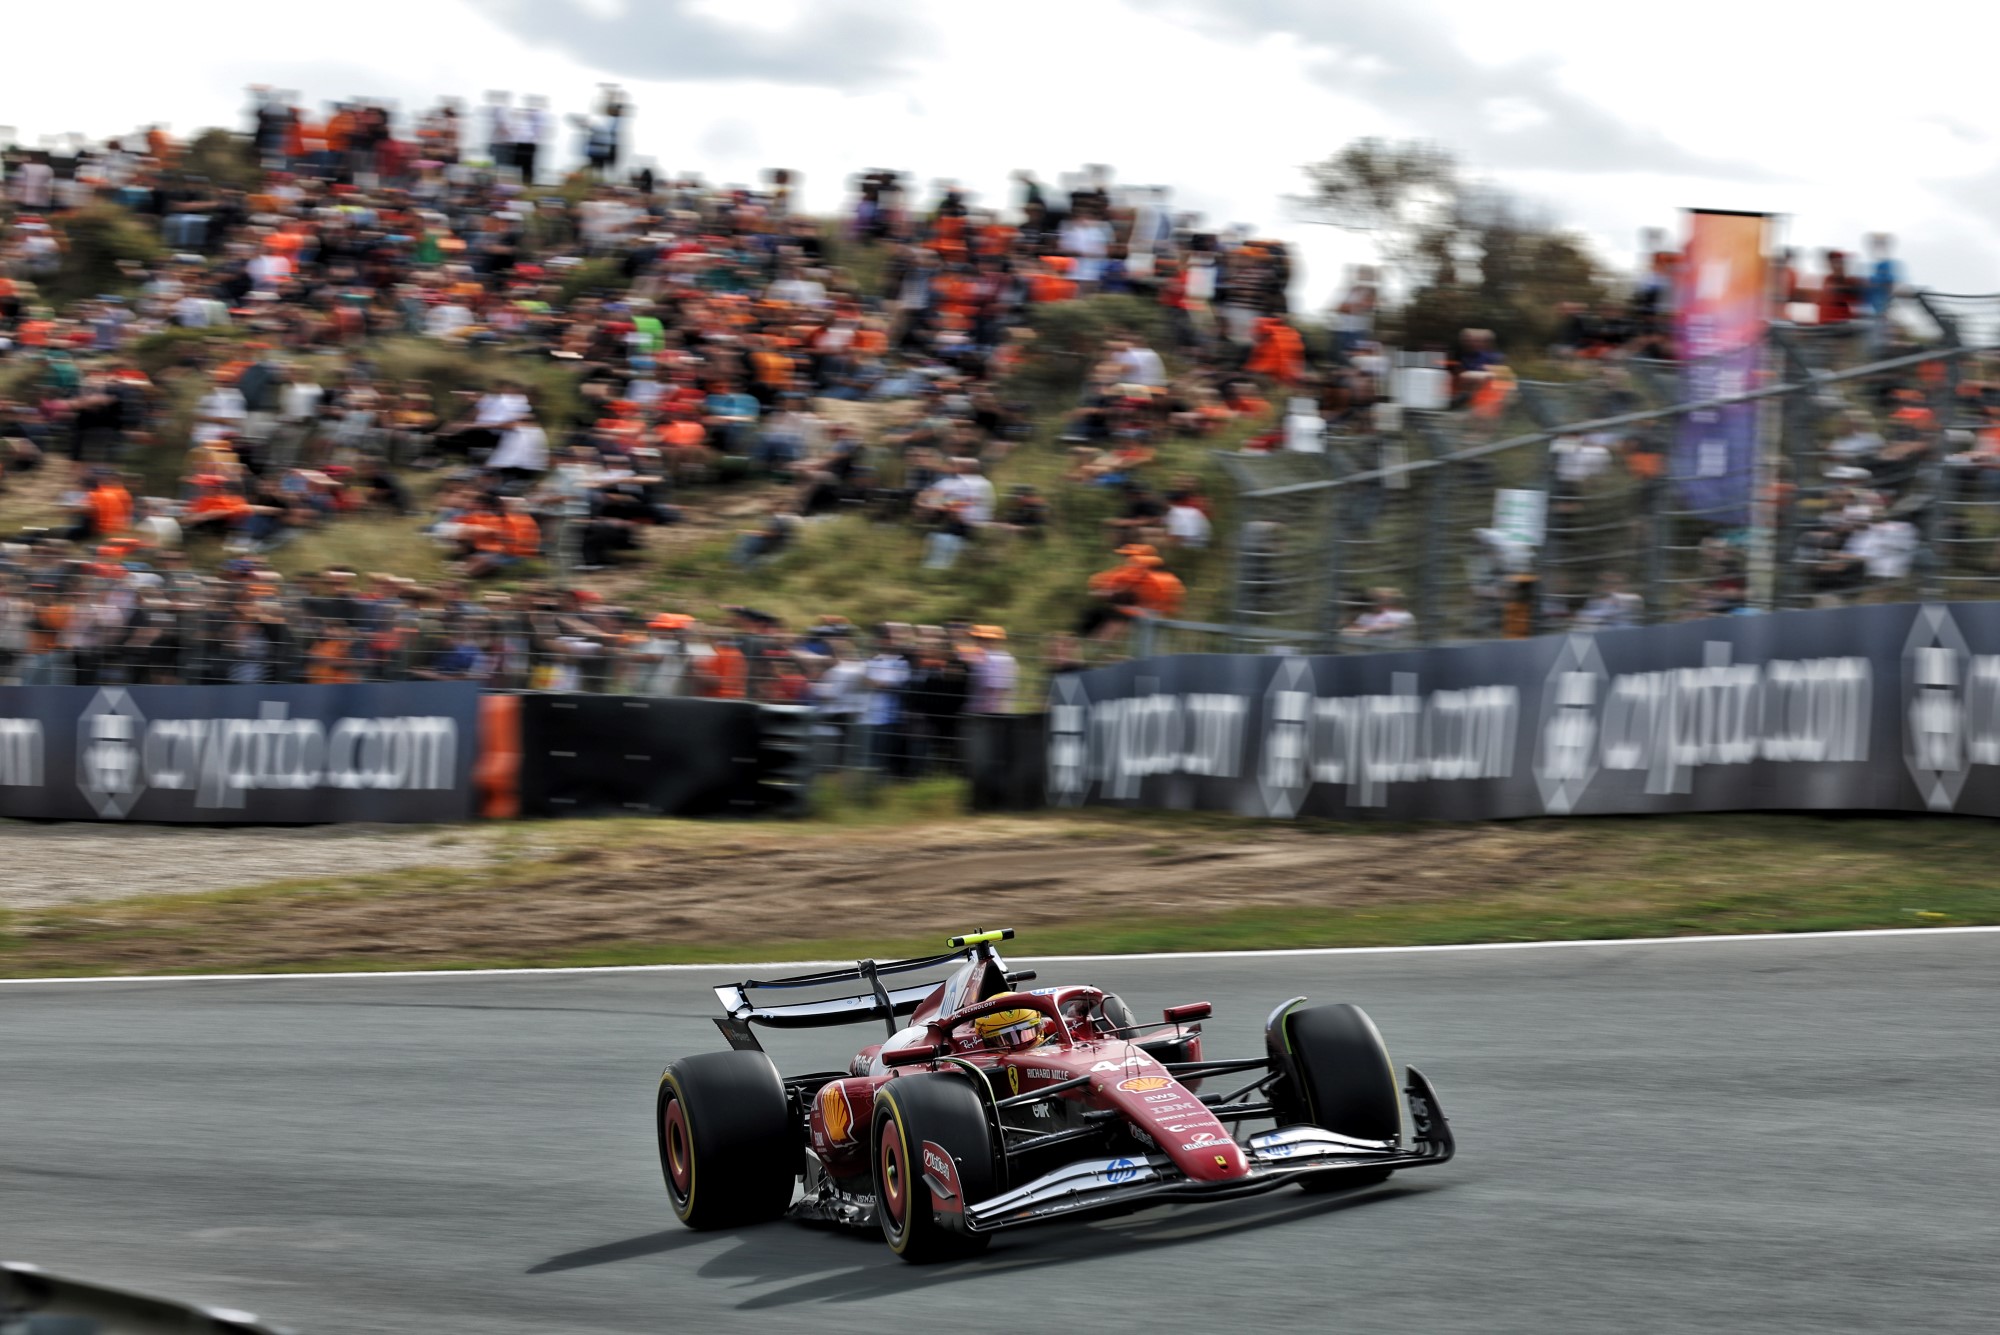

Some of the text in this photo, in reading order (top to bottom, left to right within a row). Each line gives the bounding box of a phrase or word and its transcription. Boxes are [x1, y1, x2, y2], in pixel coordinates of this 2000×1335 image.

[1601, 641, 1872, 793] crypto.com
[144, 701, 457, 809] crypto.com
[962, 1001, 997, 1015] TECHNOLOGY
[1090, 1056, 1152, 1072] 44
[1027, 1068, 1069, 1081] RICHARD MILLE
[1144, 1093, 1177, 1103] aws
[1150, 1102, 1195, 1114] IBM
[1109, 1159, 1136, 1184] hp
